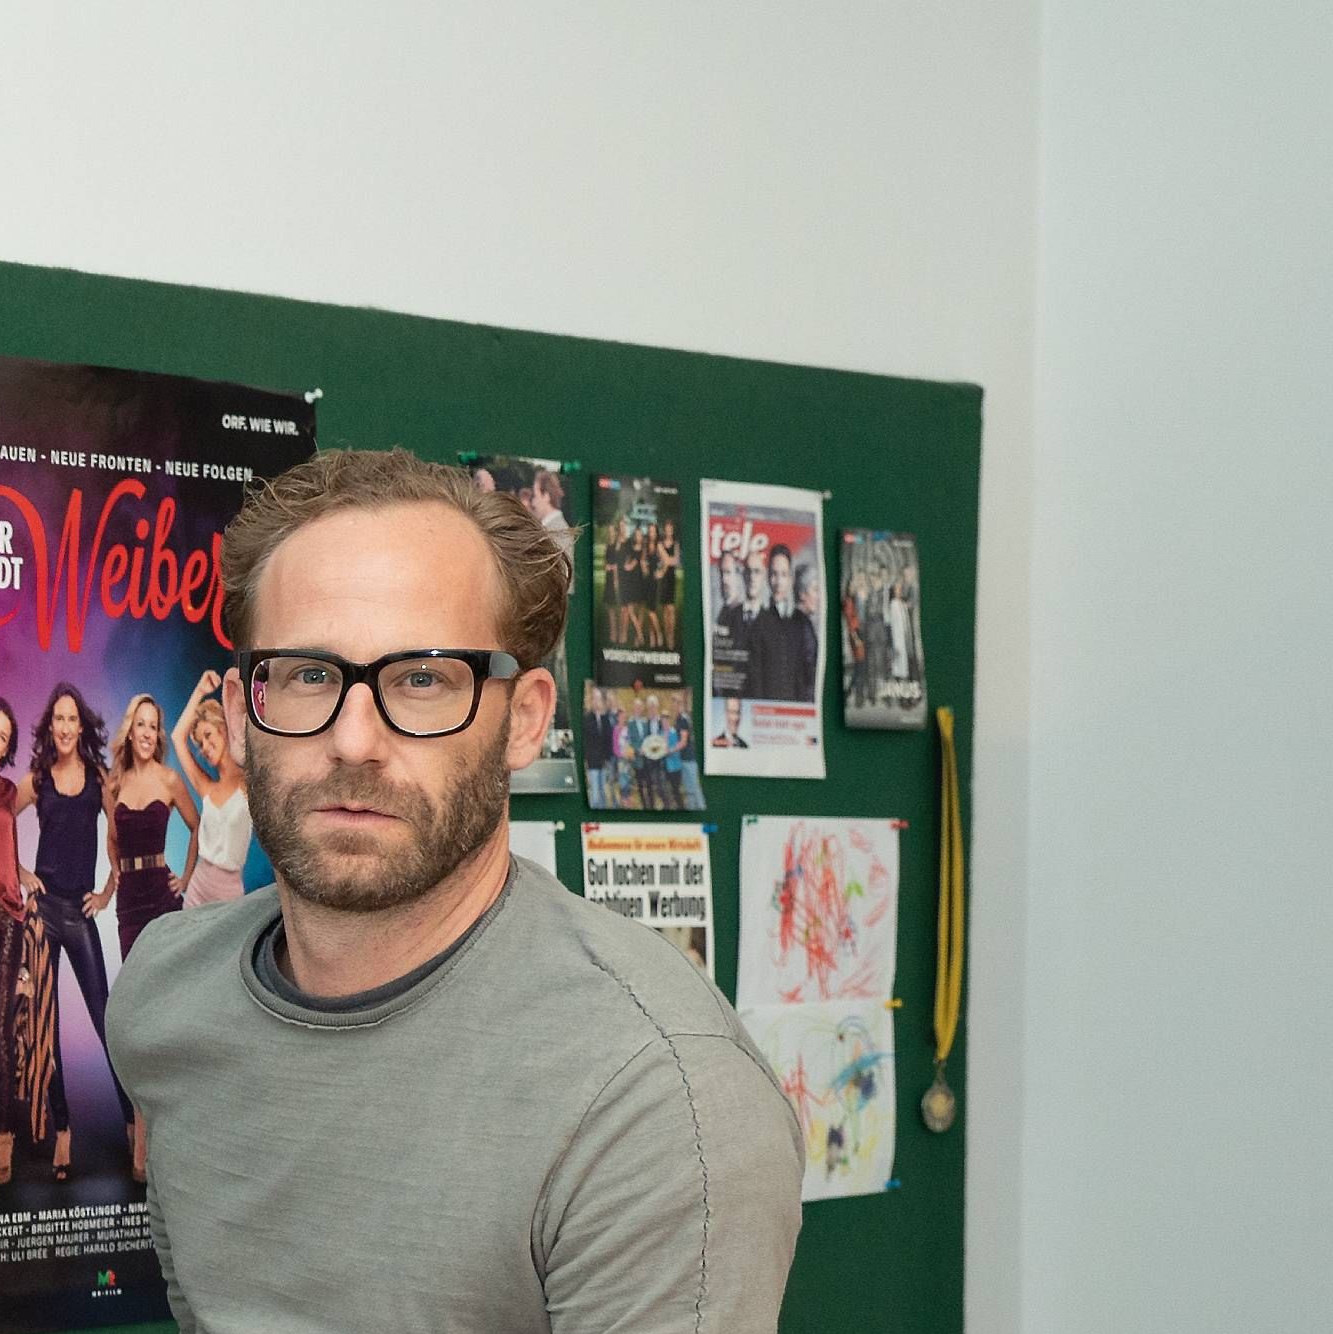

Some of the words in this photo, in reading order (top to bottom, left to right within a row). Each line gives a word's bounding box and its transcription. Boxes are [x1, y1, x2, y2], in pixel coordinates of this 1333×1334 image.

[221, 413, 248, 431] ORF.
[249, 416, 272, 433] WIE
[273, 419, 300, 437] WIR.
[50, 449, 86, 468] NEUE
[90, 453, 152, 474] FRONTEN
[165, 460, 199, 478] NEUE
[203, 463, 253, 482] FOLGEN
[710, 521, 769, 559] tele
[588, 858, 608, 885] Gut
[659, 857, 679, 885] mit
[683, 858, 703, 885] der
[648, 891, 706, 920] Werbung
[32, 1221, 69, 1235] BRIGITTE
[122, 1214, 141, 1226] INES
[39, 1208, 67, 1221] MARIA
[17, 1235, 53, 1249] JUERGEN
[56, 1231, 89, 1245] MAURER
